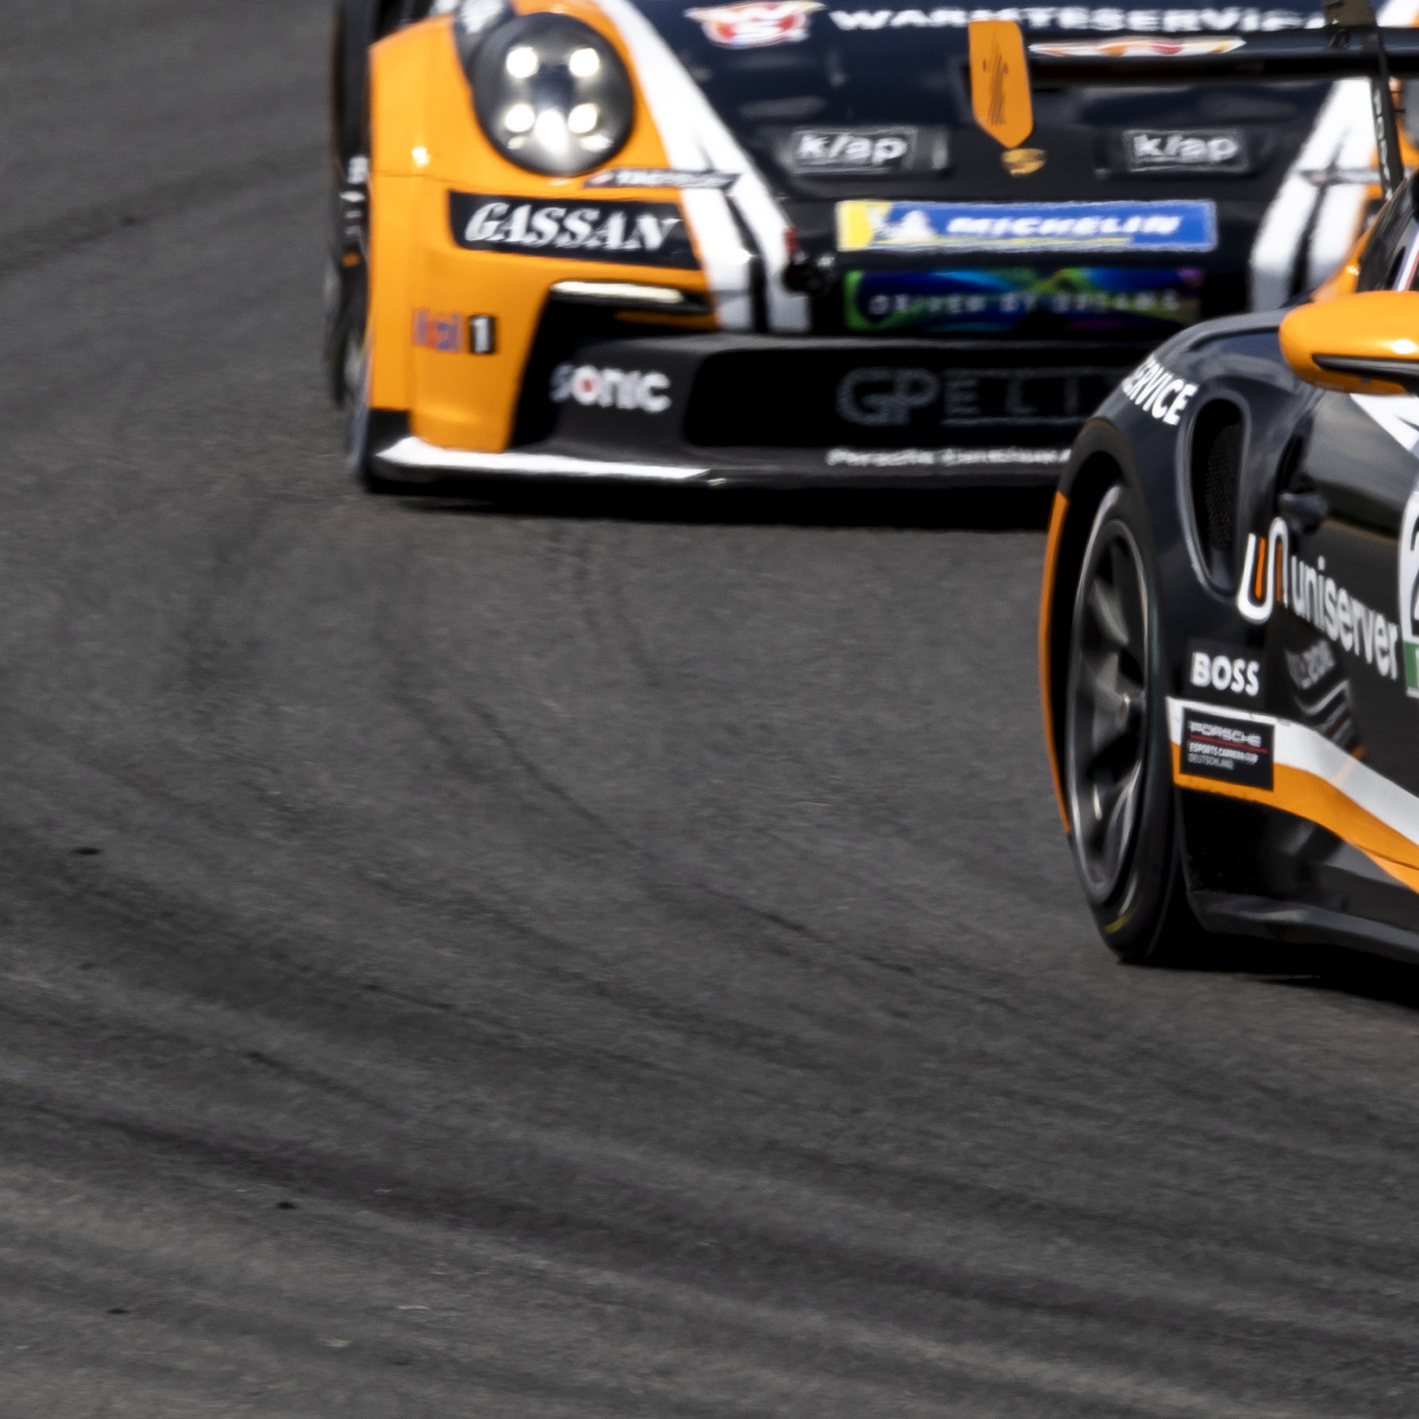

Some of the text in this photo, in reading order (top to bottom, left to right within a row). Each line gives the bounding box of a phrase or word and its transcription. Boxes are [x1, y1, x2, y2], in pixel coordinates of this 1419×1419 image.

[465, 201, 682, 251] GASSAN
[946, 215, 1184, 236] MICHELIN
[1121, 353, 1198, 426] ERVICE
[1291, 555, 1398, 680] uniserver
[1191, 651, 1260, 697] BOSS
[1189, 721, 1262, 748] PORSCHE
